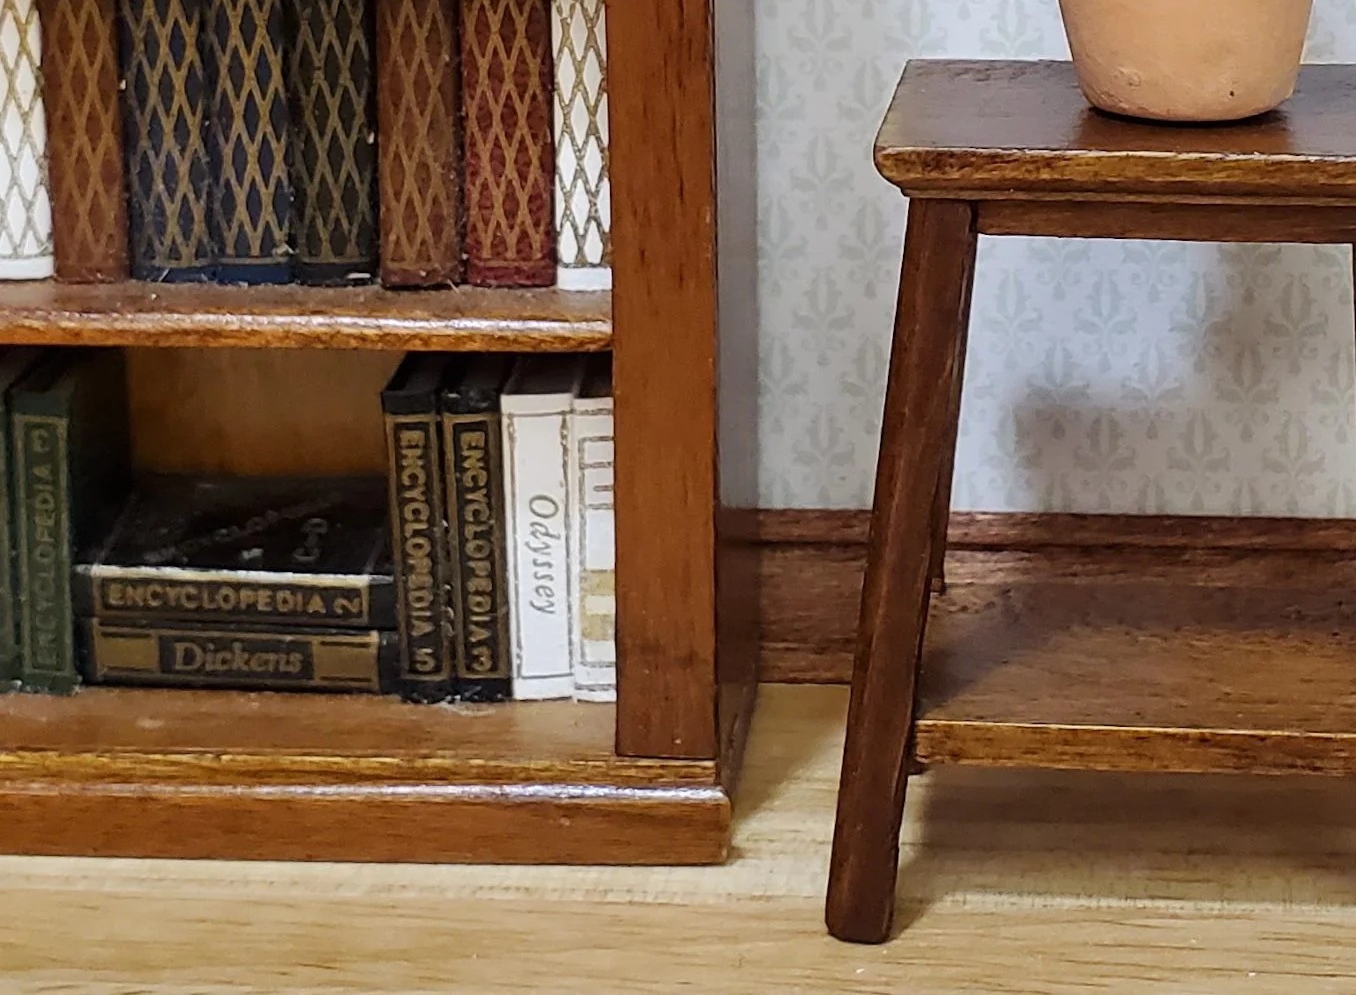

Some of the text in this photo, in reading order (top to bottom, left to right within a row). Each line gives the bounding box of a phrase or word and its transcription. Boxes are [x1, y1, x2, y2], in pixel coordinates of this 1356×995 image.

[32, 464, 57, 665] ENCYCLOPEDIA
[107, 583, 362, 615] ENCYCLOPEDIA 2
[400, 430, 436, 672] ENCYCLOPEDIA 5
[460, 430, 494, 672] ENCYCLOPEDIA 3
[523, 494, 561, 615] Odyssey
[171, 639, 305, 674] Dickens
